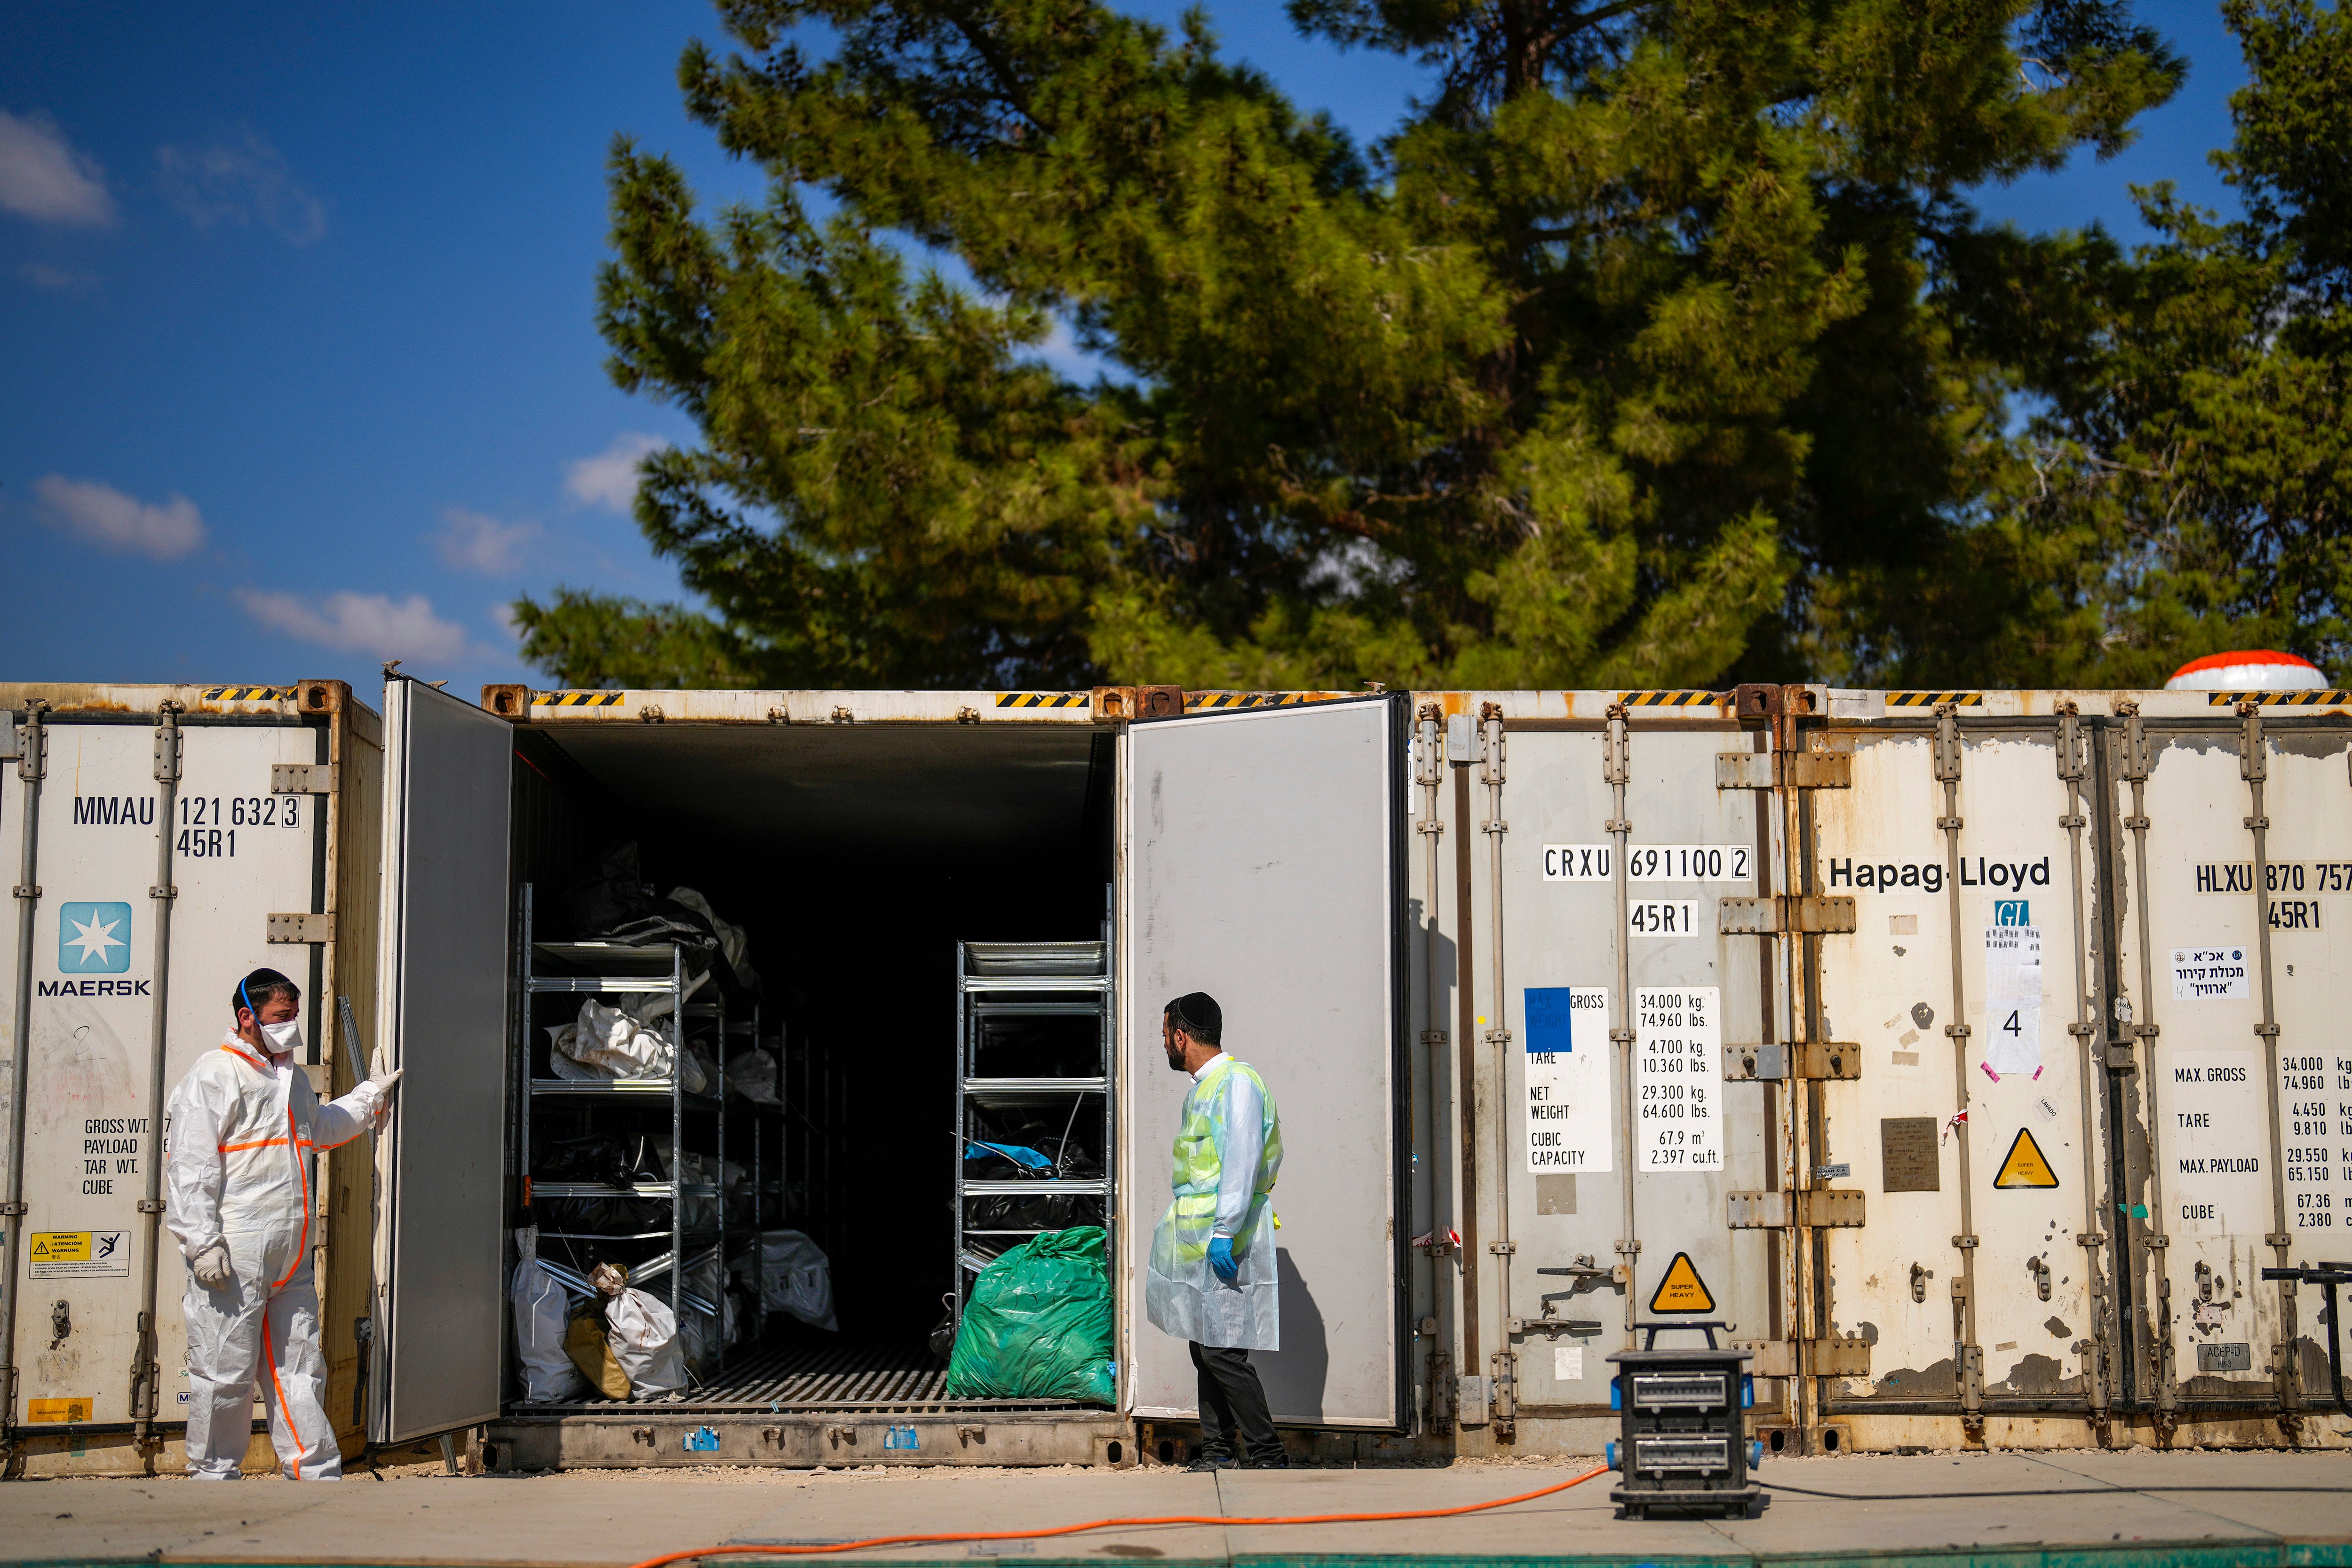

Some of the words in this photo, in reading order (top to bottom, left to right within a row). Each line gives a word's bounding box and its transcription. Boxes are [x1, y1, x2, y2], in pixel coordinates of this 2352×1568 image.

[74, 797, 154, 824] MMAU
[180, 797, 219, 825] 121
[232, 797, 276, 825] 632
[285, 800, 296, 825] 3
[177, 830, 235, 857] 45R1
[1546, 849, 1609, 876] CRXU
[1631, 850, 1721, 877] 691100
[1735, 850, 1746, 876] 2
[2197, 865, 2252, 892] HLXU
[2266, 864, 2304, 891] 870
[2316, 864, 2352, 891] 757
[1632, 905, 1689, 932] 45R1
[1997, 902, 2027, 927] GL
[2269, 901, 2320, 928] 45R1
[2176, 968, 2206, 980] קירור
[2209, 966, 2244, 978] מכולת
[39, 981, 151, 996] MAERSK
[1571, 995, 1604, 1008] GROSS
[1689, 995, 1704, 1010] kg.
[1690, 1013, 1708, 1027] lbs.
[2003, 1010, 2022, 1037] 4
[1690, 1040, 1705, 1056] kg.
[1691, 1059, 1709, 1072] lbs.
[2176, 1069, 2205, 1082] MAX.
[2208, 1068, 2246, 1081] GROSS
[2338, 1076, 2352, 1089] lb
[1531, 1087, 1549, 1100] NET
[1692, 1085, 1706, 1101] kg.
[1531, 1105, 1569, 1119] WEIGHT
[1692, 1104, 1710, 1118] lbs.
[2041, 1099, 2056, 1117] LAVADO
[86, 1119, 124, 1134] GROSS
[128, 1119, 149, 1133] WT.
[2178, 1114, 2209, 1128] TARE
[1532, 1132, 1561, 1146] CUBIC
[1660, 1131, 1684, 1145] 67.9
[85, 1139, 137, 1154] PAYLOAD
[1533, 1151, 1585, 1165] CAPACITY
[1693, 1149, 1719, 1163] cu.ft.
[2343, 1148, 2352, 1164] k
[84, 1160, 106, 1174] TAR
[117, 1159, 138, 1174] WT.
[2180, 1159, 2208, 1173] MAX.
[2211, 1158, 2258, 1172] PAYLOAD
[83, 1180, 113, 1195] CUBE
[2298, 1194, 2330, 1208] 67.36
[2183, 1205, 2215, 1219] CUBE
[2207, 1346, 2241, 1358] ACEP-D
